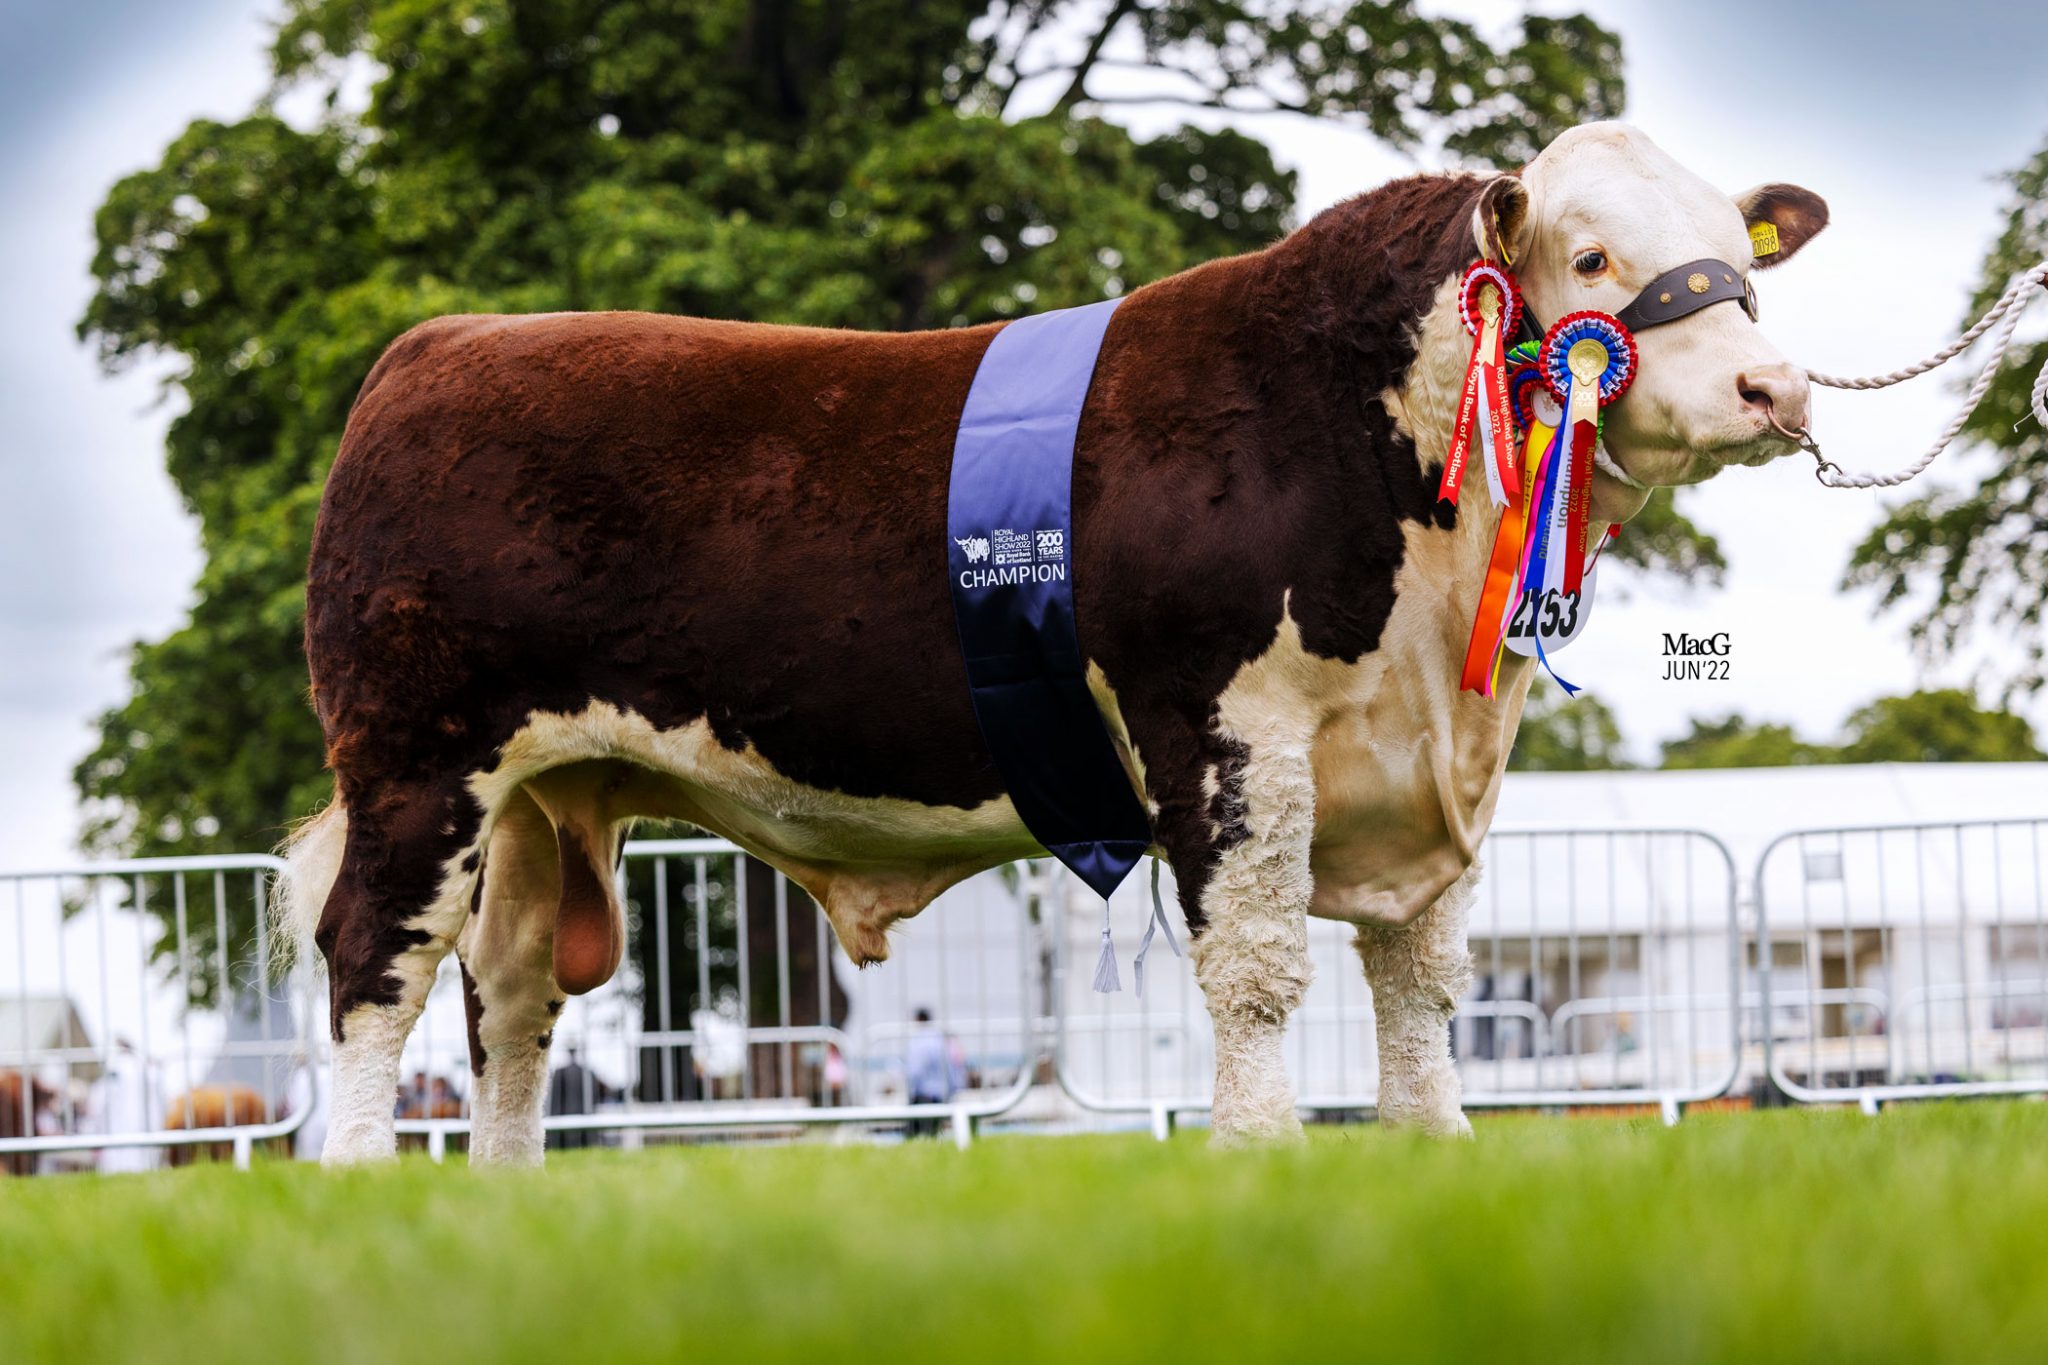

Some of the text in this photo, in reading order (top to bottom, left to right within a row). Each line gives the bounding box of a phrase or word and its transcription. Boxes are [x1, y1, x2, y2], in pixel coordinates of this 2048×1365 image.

[1446, 365, 1481, 487] Royal Bank of Scotland
[1490, 410, 1502, 435] 2022
[1496, 366, 1515, 469] Royal Highland Show
[1569, 488, 1580, 513] 2022
[1579, 447, 1596, 553] Royal Highland Show
[994, 533, 1029, 543] HIGHLAND
[1015, 541, 1031, 549] 2022
[1036, 532, 1064, 547] 200
[1037, 546, 1064, 555] YEARS
[960, 563, 1065, 589] CHAMPION
[1507, 588, 1581, 638] 2153
